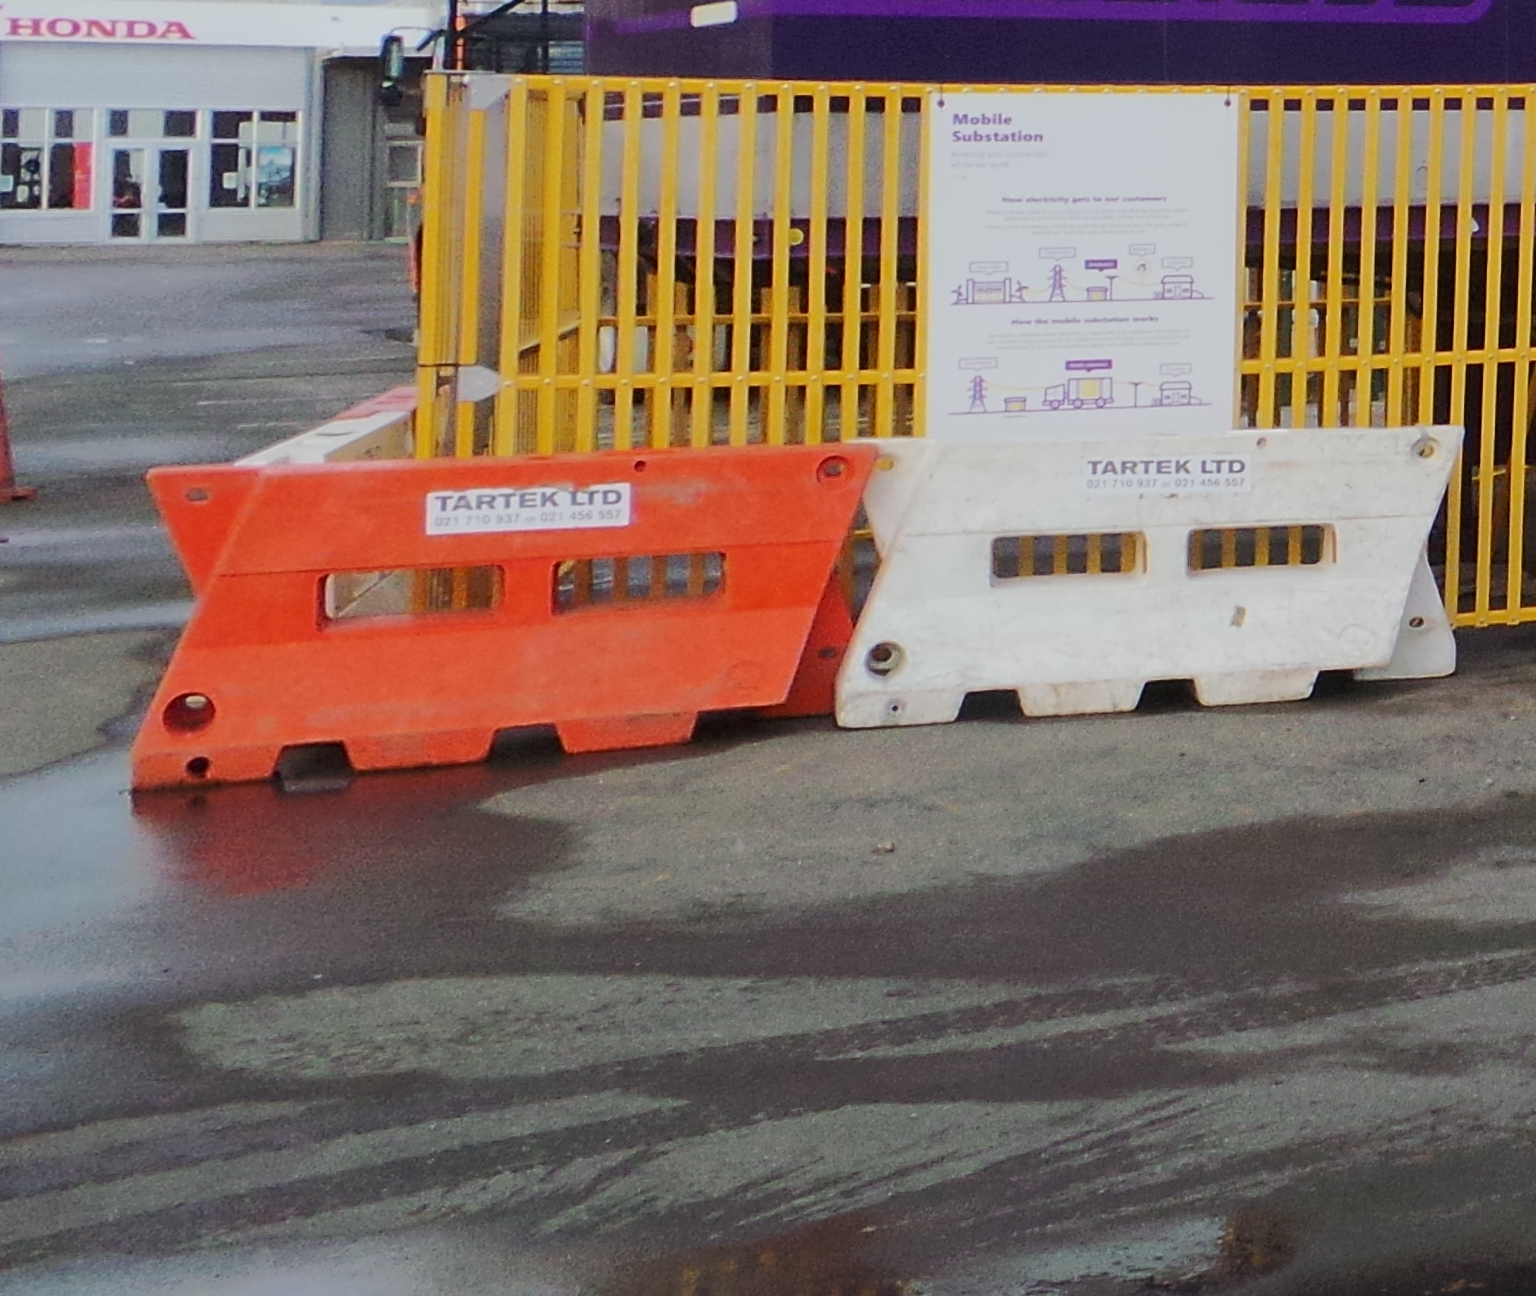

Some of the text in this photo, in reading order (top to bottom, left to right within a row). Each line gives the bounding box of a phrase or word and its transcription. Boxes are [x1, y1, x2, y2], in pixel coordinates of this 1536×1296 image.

[6, 17, 195, 40] HONDA
[952, 112, 1013, 126] Mobile
[952, 130, 1045, 143] Substation
[1087, 459, 1247, 475] TARTEK LTD
[1086, 479, 1107, 489] 021
[1112, 479, 1133, 488] 710
[1137, 478, 1158, 488] 937
[1174, 478, 1195, 488] 021
[1200, 478, 1221, 487] 456
[1225, 477, 1246, 487] 557
[435, 489, 622, 512] TARTEK LTD
[435, 516, 459, 527] 021
[466, 515, 491, 525] 710
[496, 513, 520, 524] 937
[540, 512, 564, 522] 021
